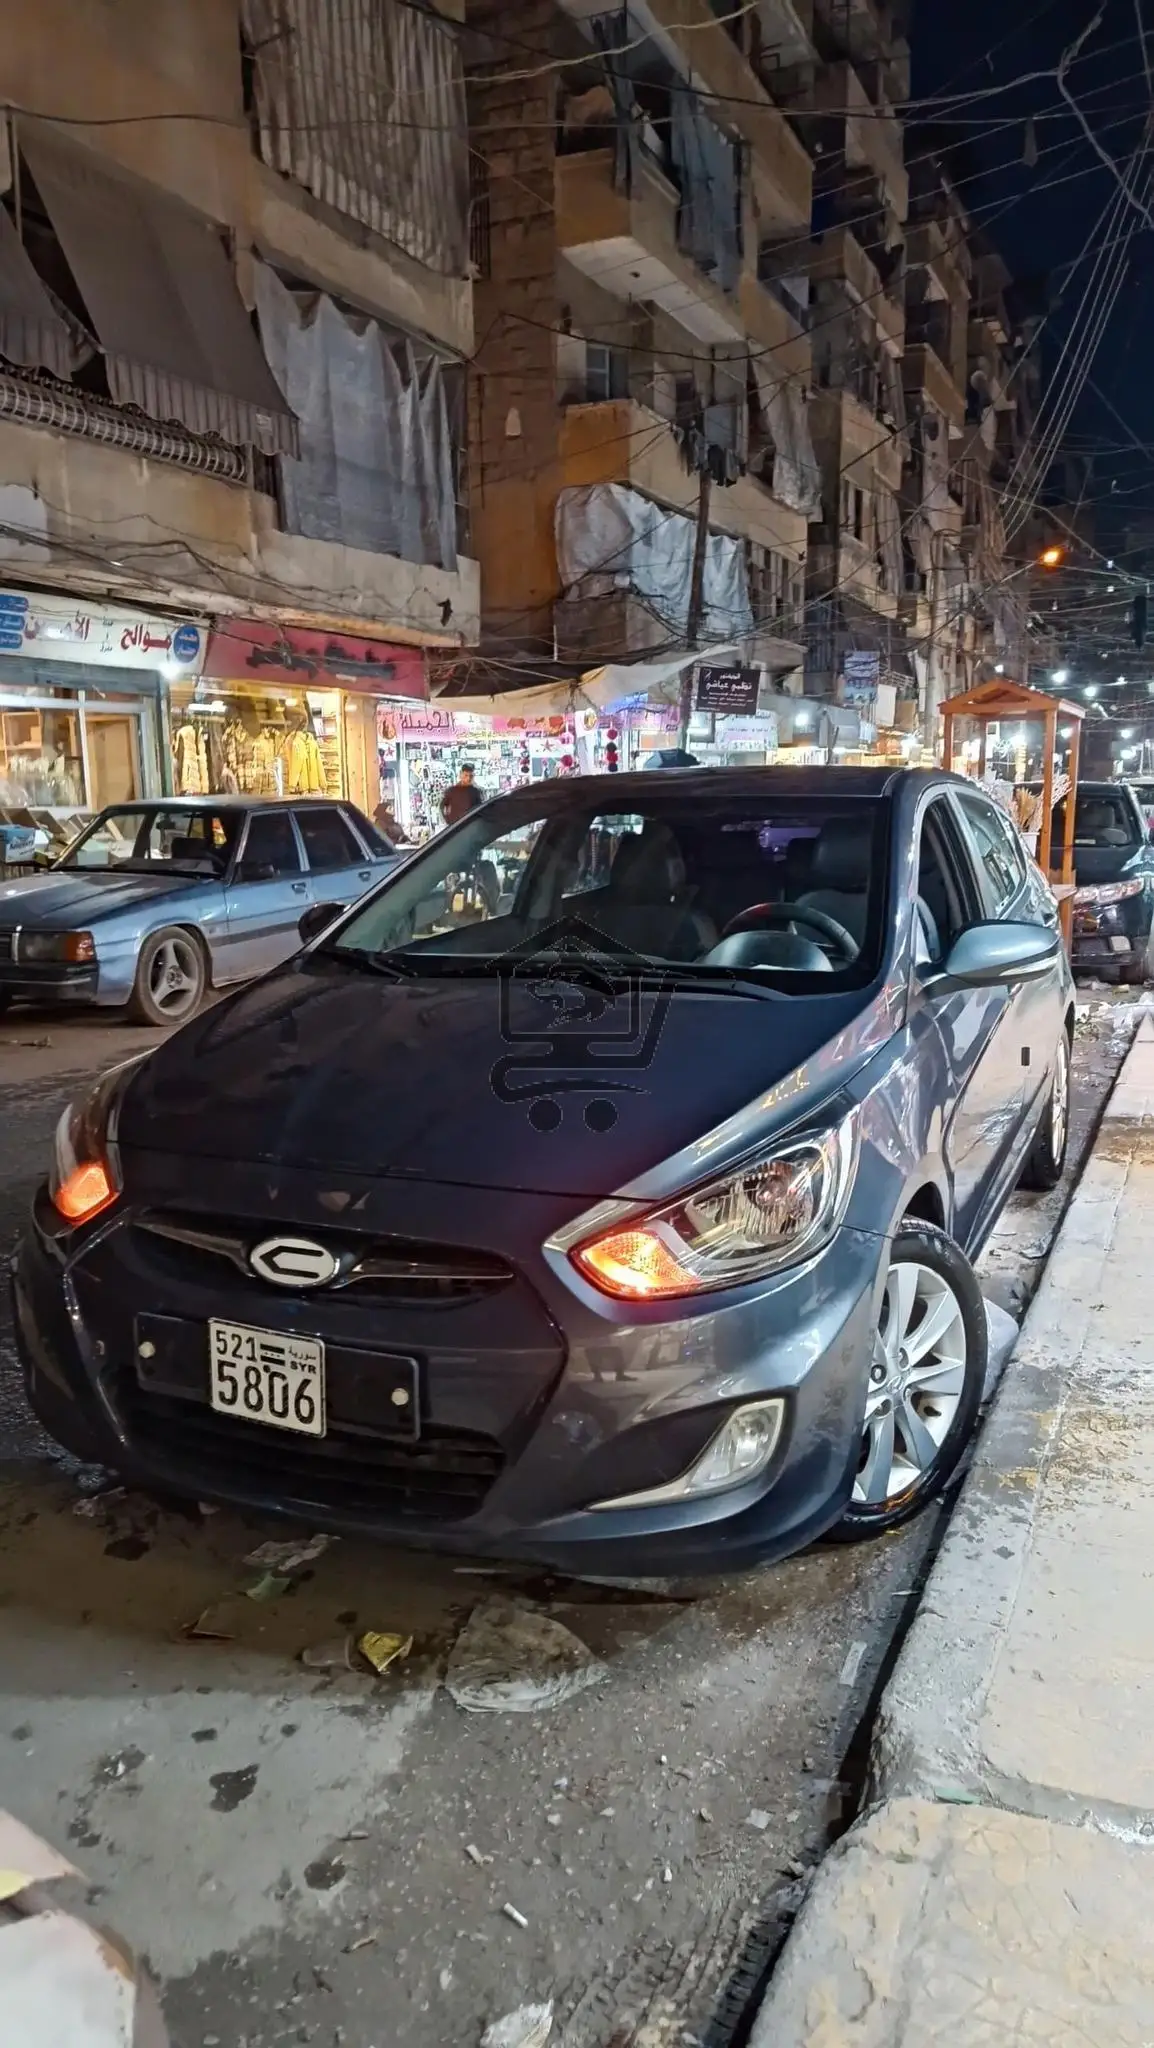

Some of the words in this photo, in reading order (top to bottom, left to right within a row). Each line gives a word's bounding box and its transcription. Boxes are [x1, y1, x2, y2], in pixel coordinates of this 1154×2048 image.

[120, 624, 172, 652] موالح
[399, 711, 456, 733] الجميلة
[215, 1329, 258, 1363] 521
[289, 1361, 317, 1374] SYR
[217, 1359, 316, 1425] 5806
